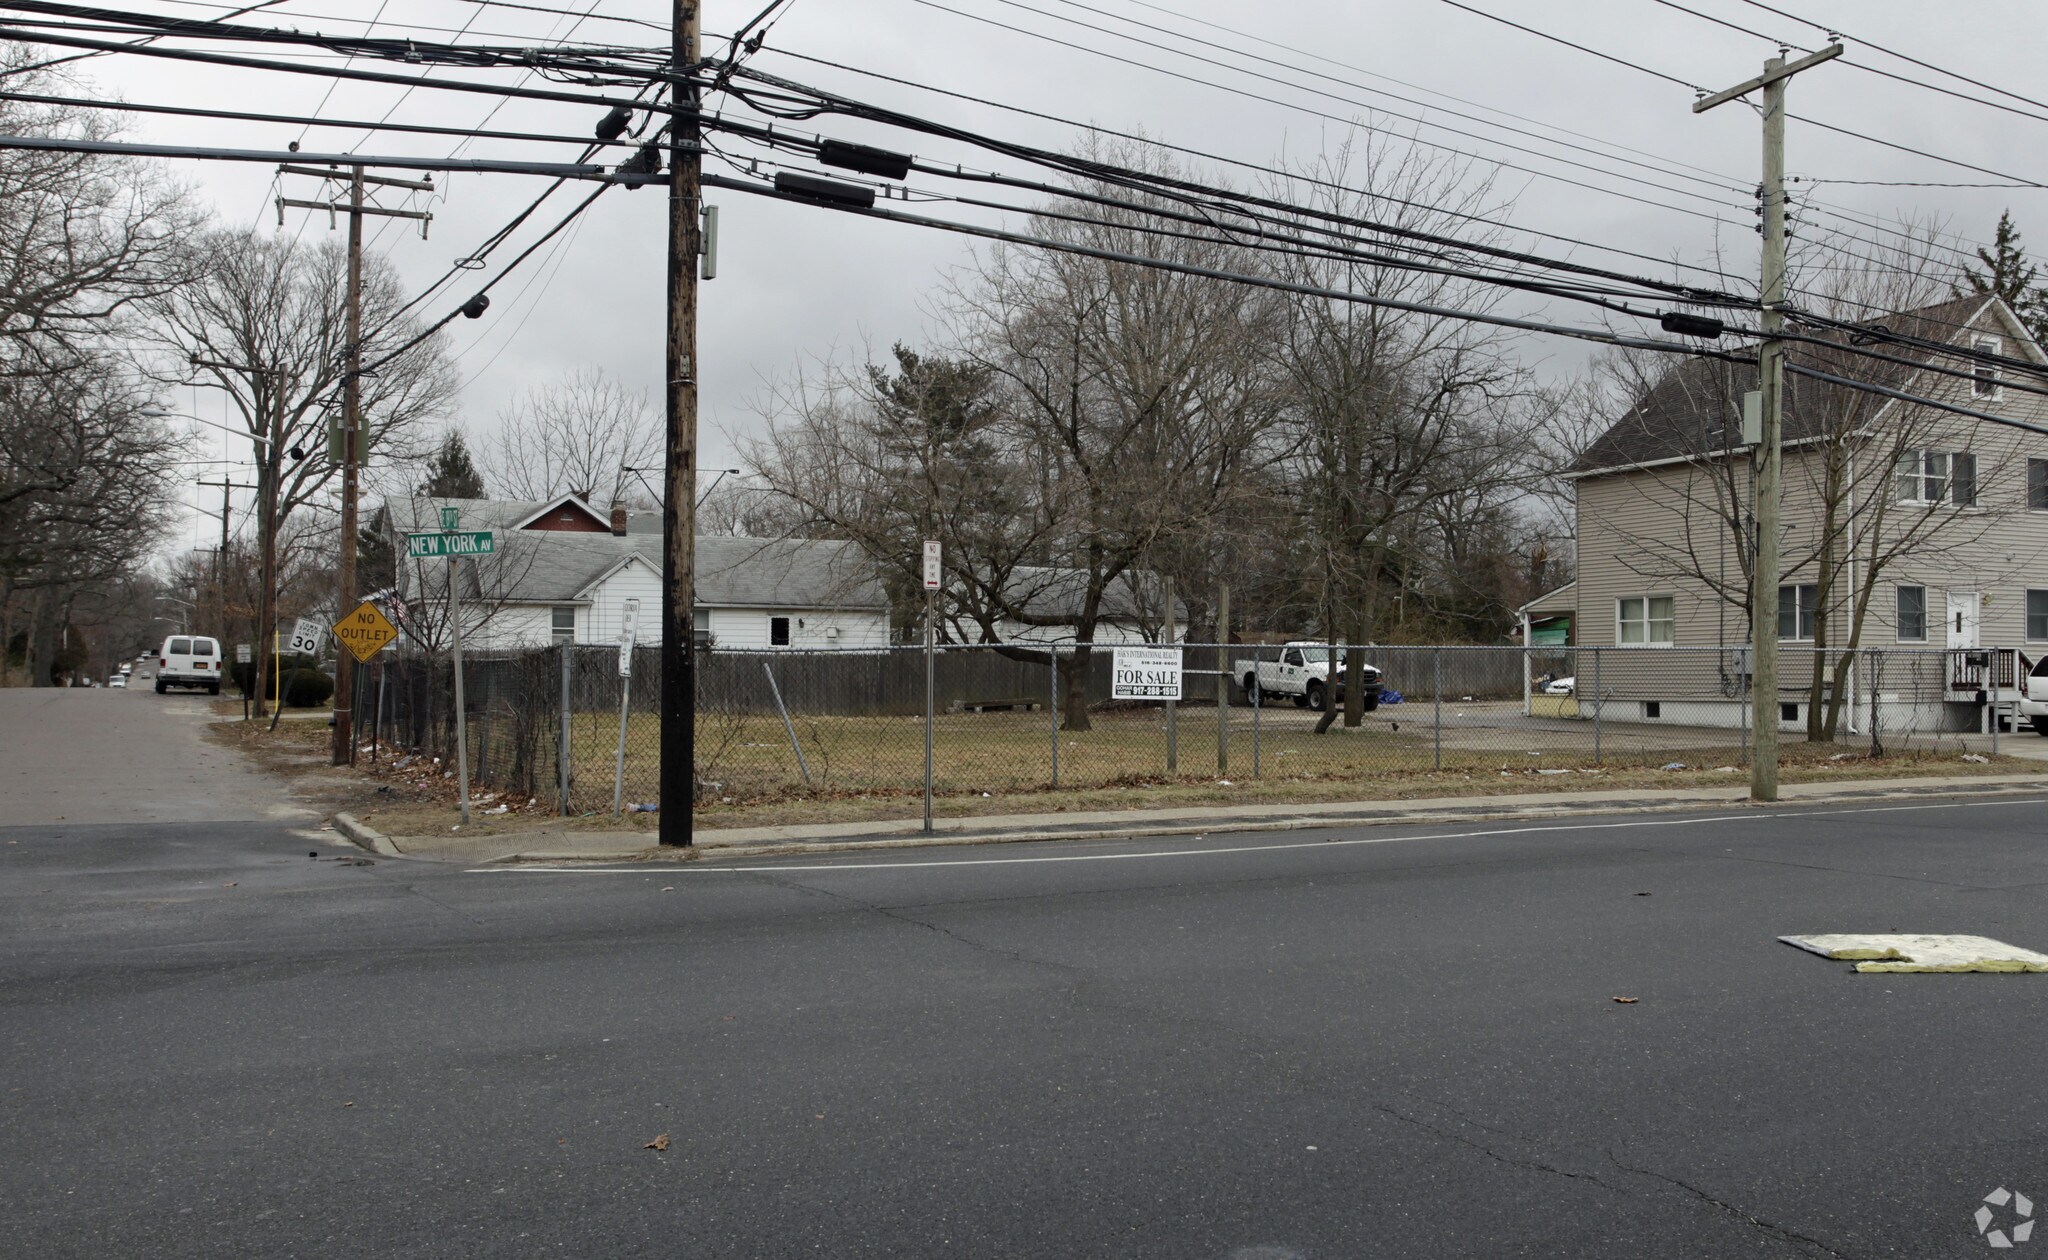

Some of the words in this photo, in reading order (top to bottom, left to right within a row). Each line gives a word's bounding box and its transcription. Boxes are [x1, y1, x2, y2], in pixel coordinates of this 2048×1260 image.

[410, 536, 438, 554] NEW
[442, 535, 478, 553] YORK
[480, 539, 491, 551] AV
[929, 545, 936, 553] NO
[357, 613, 375, 624] NO
[299, 626, 318, 634] SPEED
[302, 622, 318, 630] TOWN
[341, 627, 388, 640] OUTLET
[292, 635, 315, 651] 30
[1129, 650, 1162, 658] INTERNATIONAL
[1162, 651, 1178, 659] REALTY
[1116, 669, 1144, 684] FOR
[1146, 670, 1178, 685] SALE
[1132, 686, 1177, 695] 917-288-1515
